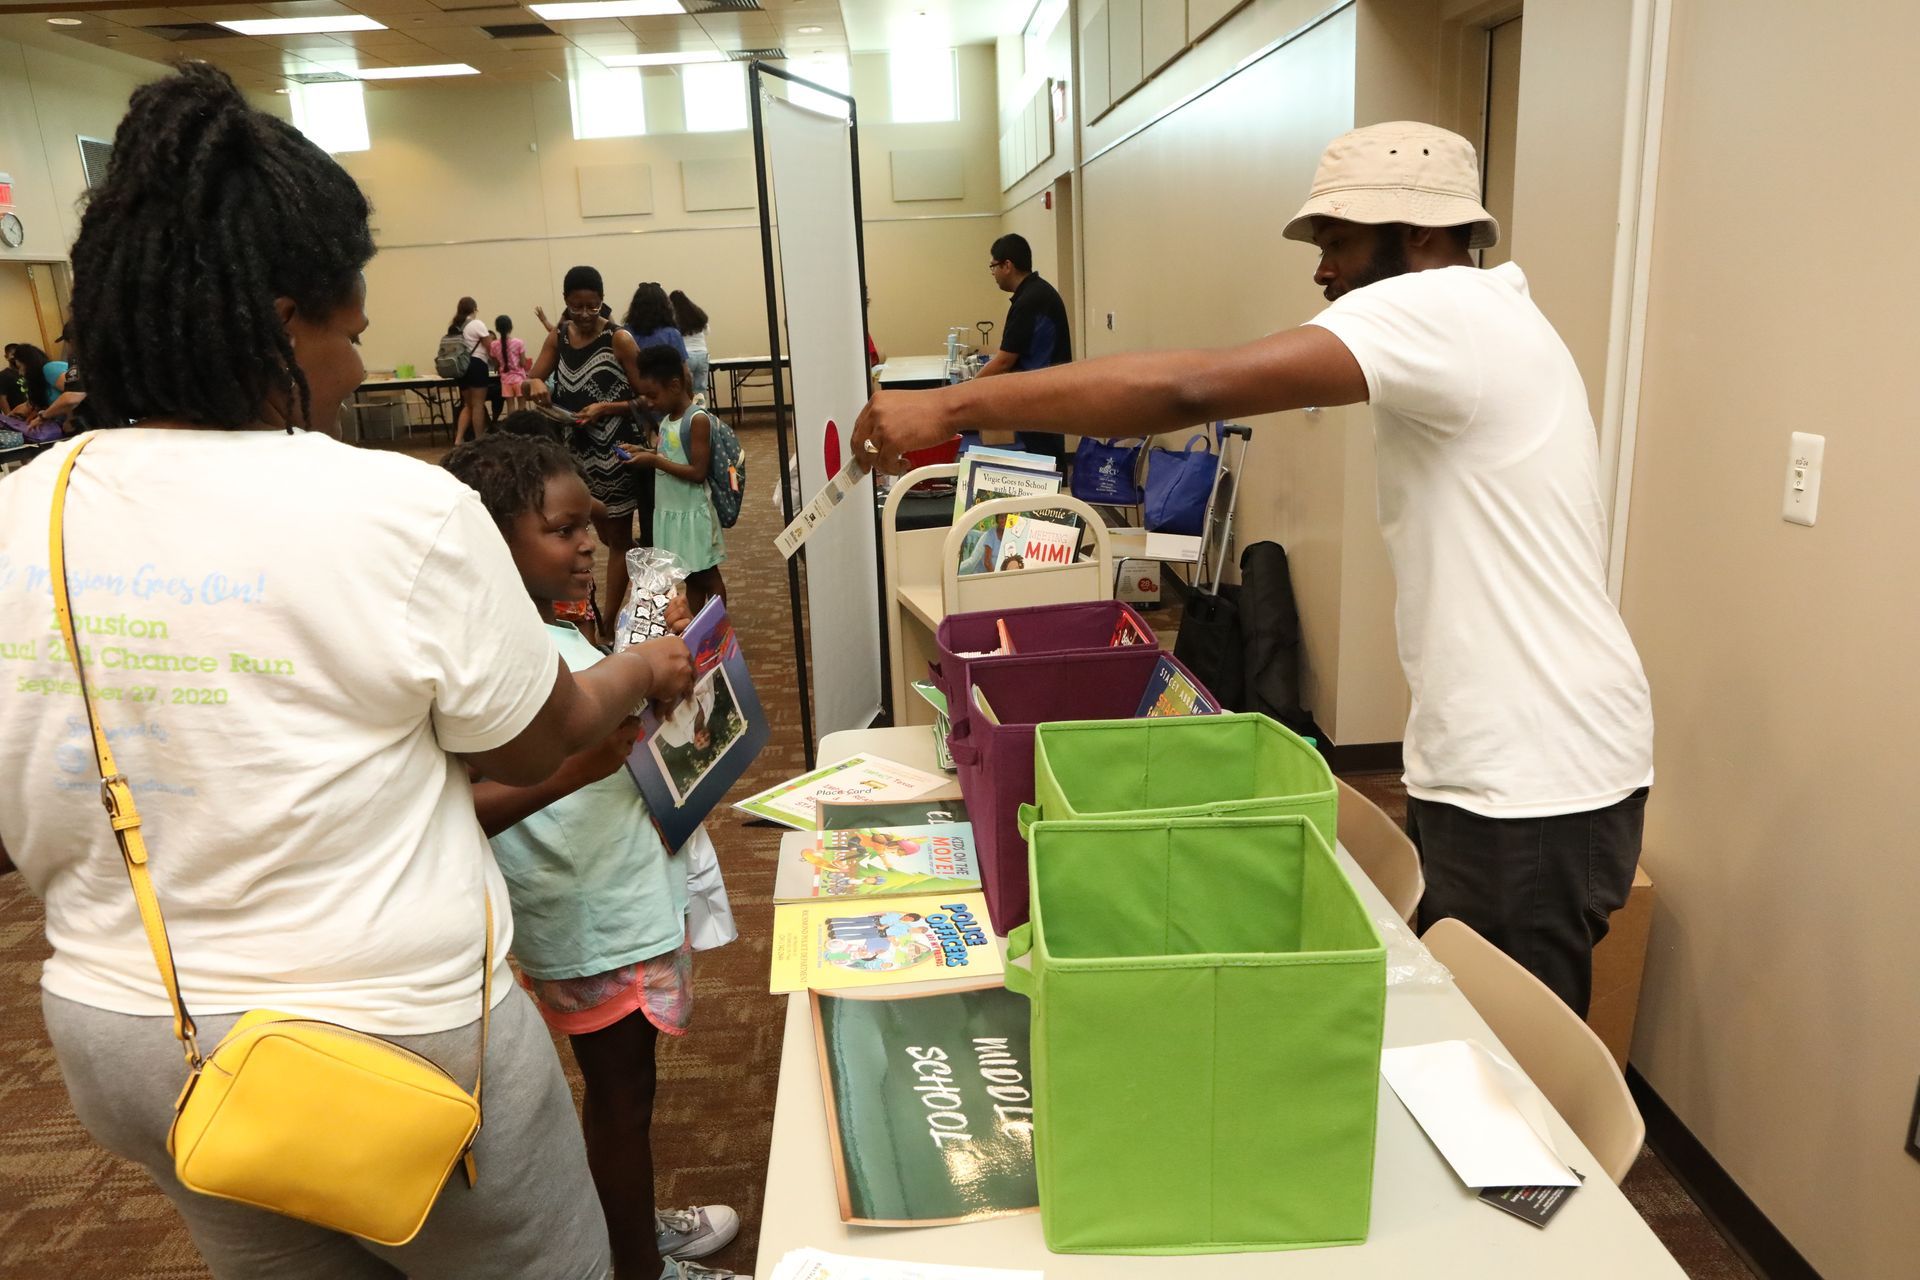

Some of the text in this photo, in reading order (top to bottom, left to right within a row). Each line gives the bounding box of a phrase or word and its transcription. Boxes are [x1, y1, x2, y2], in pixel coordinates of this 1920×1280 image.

[984, 474, 1001, 484] Virgie
[1002, 476, 1017, 486] Goes
[1025, 480, 1048, 490] School
[1008, 487, 1017, 496] Us
[1025, 541, 1071, 564] MIMI
[1031, 528, 1068, 544] MEETING
[26, 564, 129, 598] Mssion
[131, 563, 194, 605] Goes
[200, 571, 266, 605] On!
[48, 638, 95, 666] 2d
[100, 646, 219, 674] Chance
[229, 652, 296, 676] Run
[16, 675, 123, 702] Septemer
[172, 687, 229, 705] 2020
[1160, 668, 1180, 692] STACEY
[846, 788, 872, 796] Card
[931, 836, 954, 875] MOVE!
[952, 836, 969, 876] KIDS ON THE
[925, 913, 969, 967] OFFICERS
[940, 903, 988, 946] POLICE
[905, 1046, 973, 1149] SCHOOL
